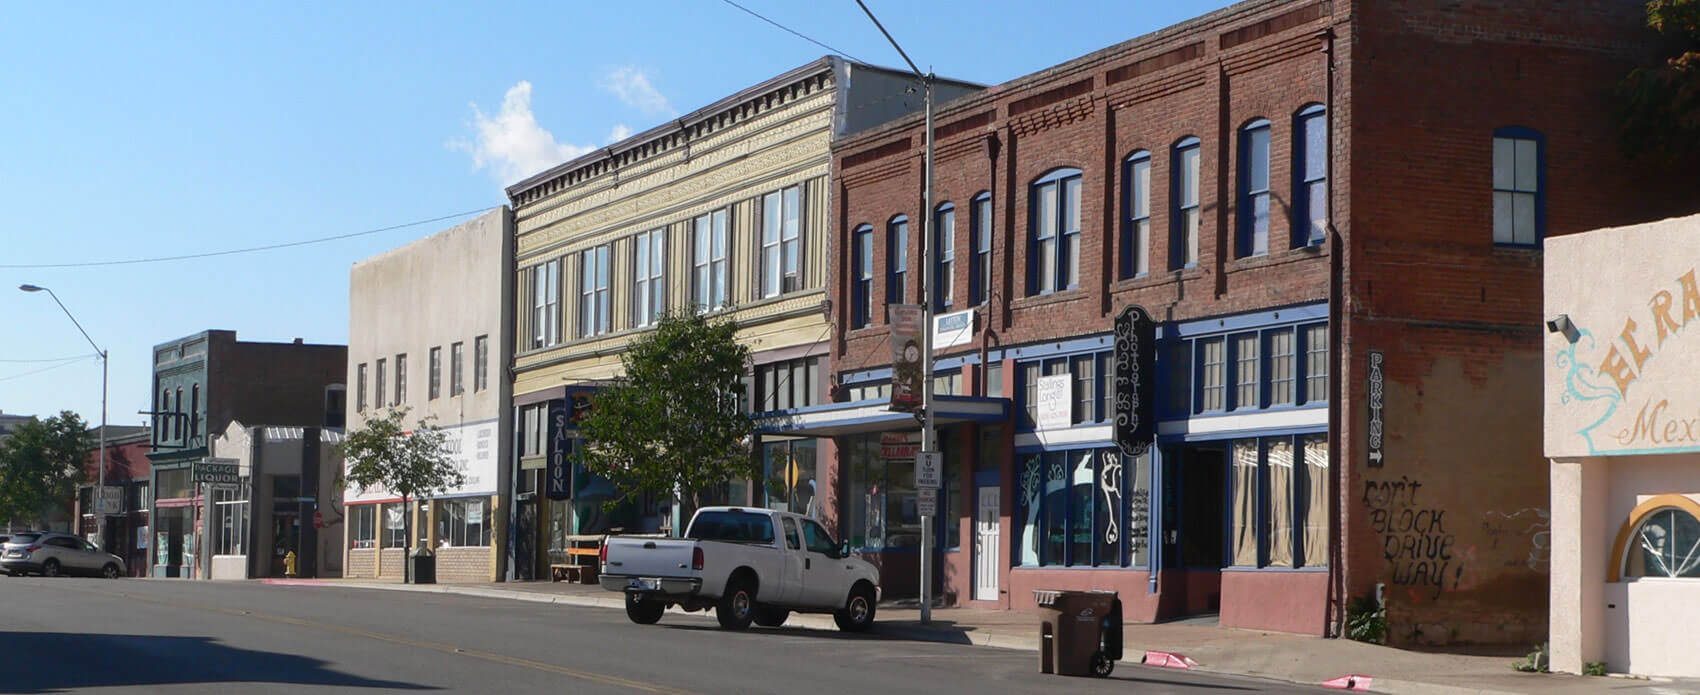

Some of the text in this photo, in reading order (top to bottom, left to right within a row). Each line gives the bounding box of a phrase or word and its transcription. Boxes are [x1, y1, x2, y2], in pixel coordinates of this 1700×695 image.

[1128, 310, 1141, 433] Photography
[1598, 315, 1653, 401] EL
[1370, 353, 1383, 449] PARKING
[1608, 395, 1700, 446] Mex
[195, 463, 238, 474] PACKAGE
[195, 473, 239, 483] LIQUOR
[553, 414, 565, 493] SALOON
[1371, 508, 1446, 535] BLOCK
